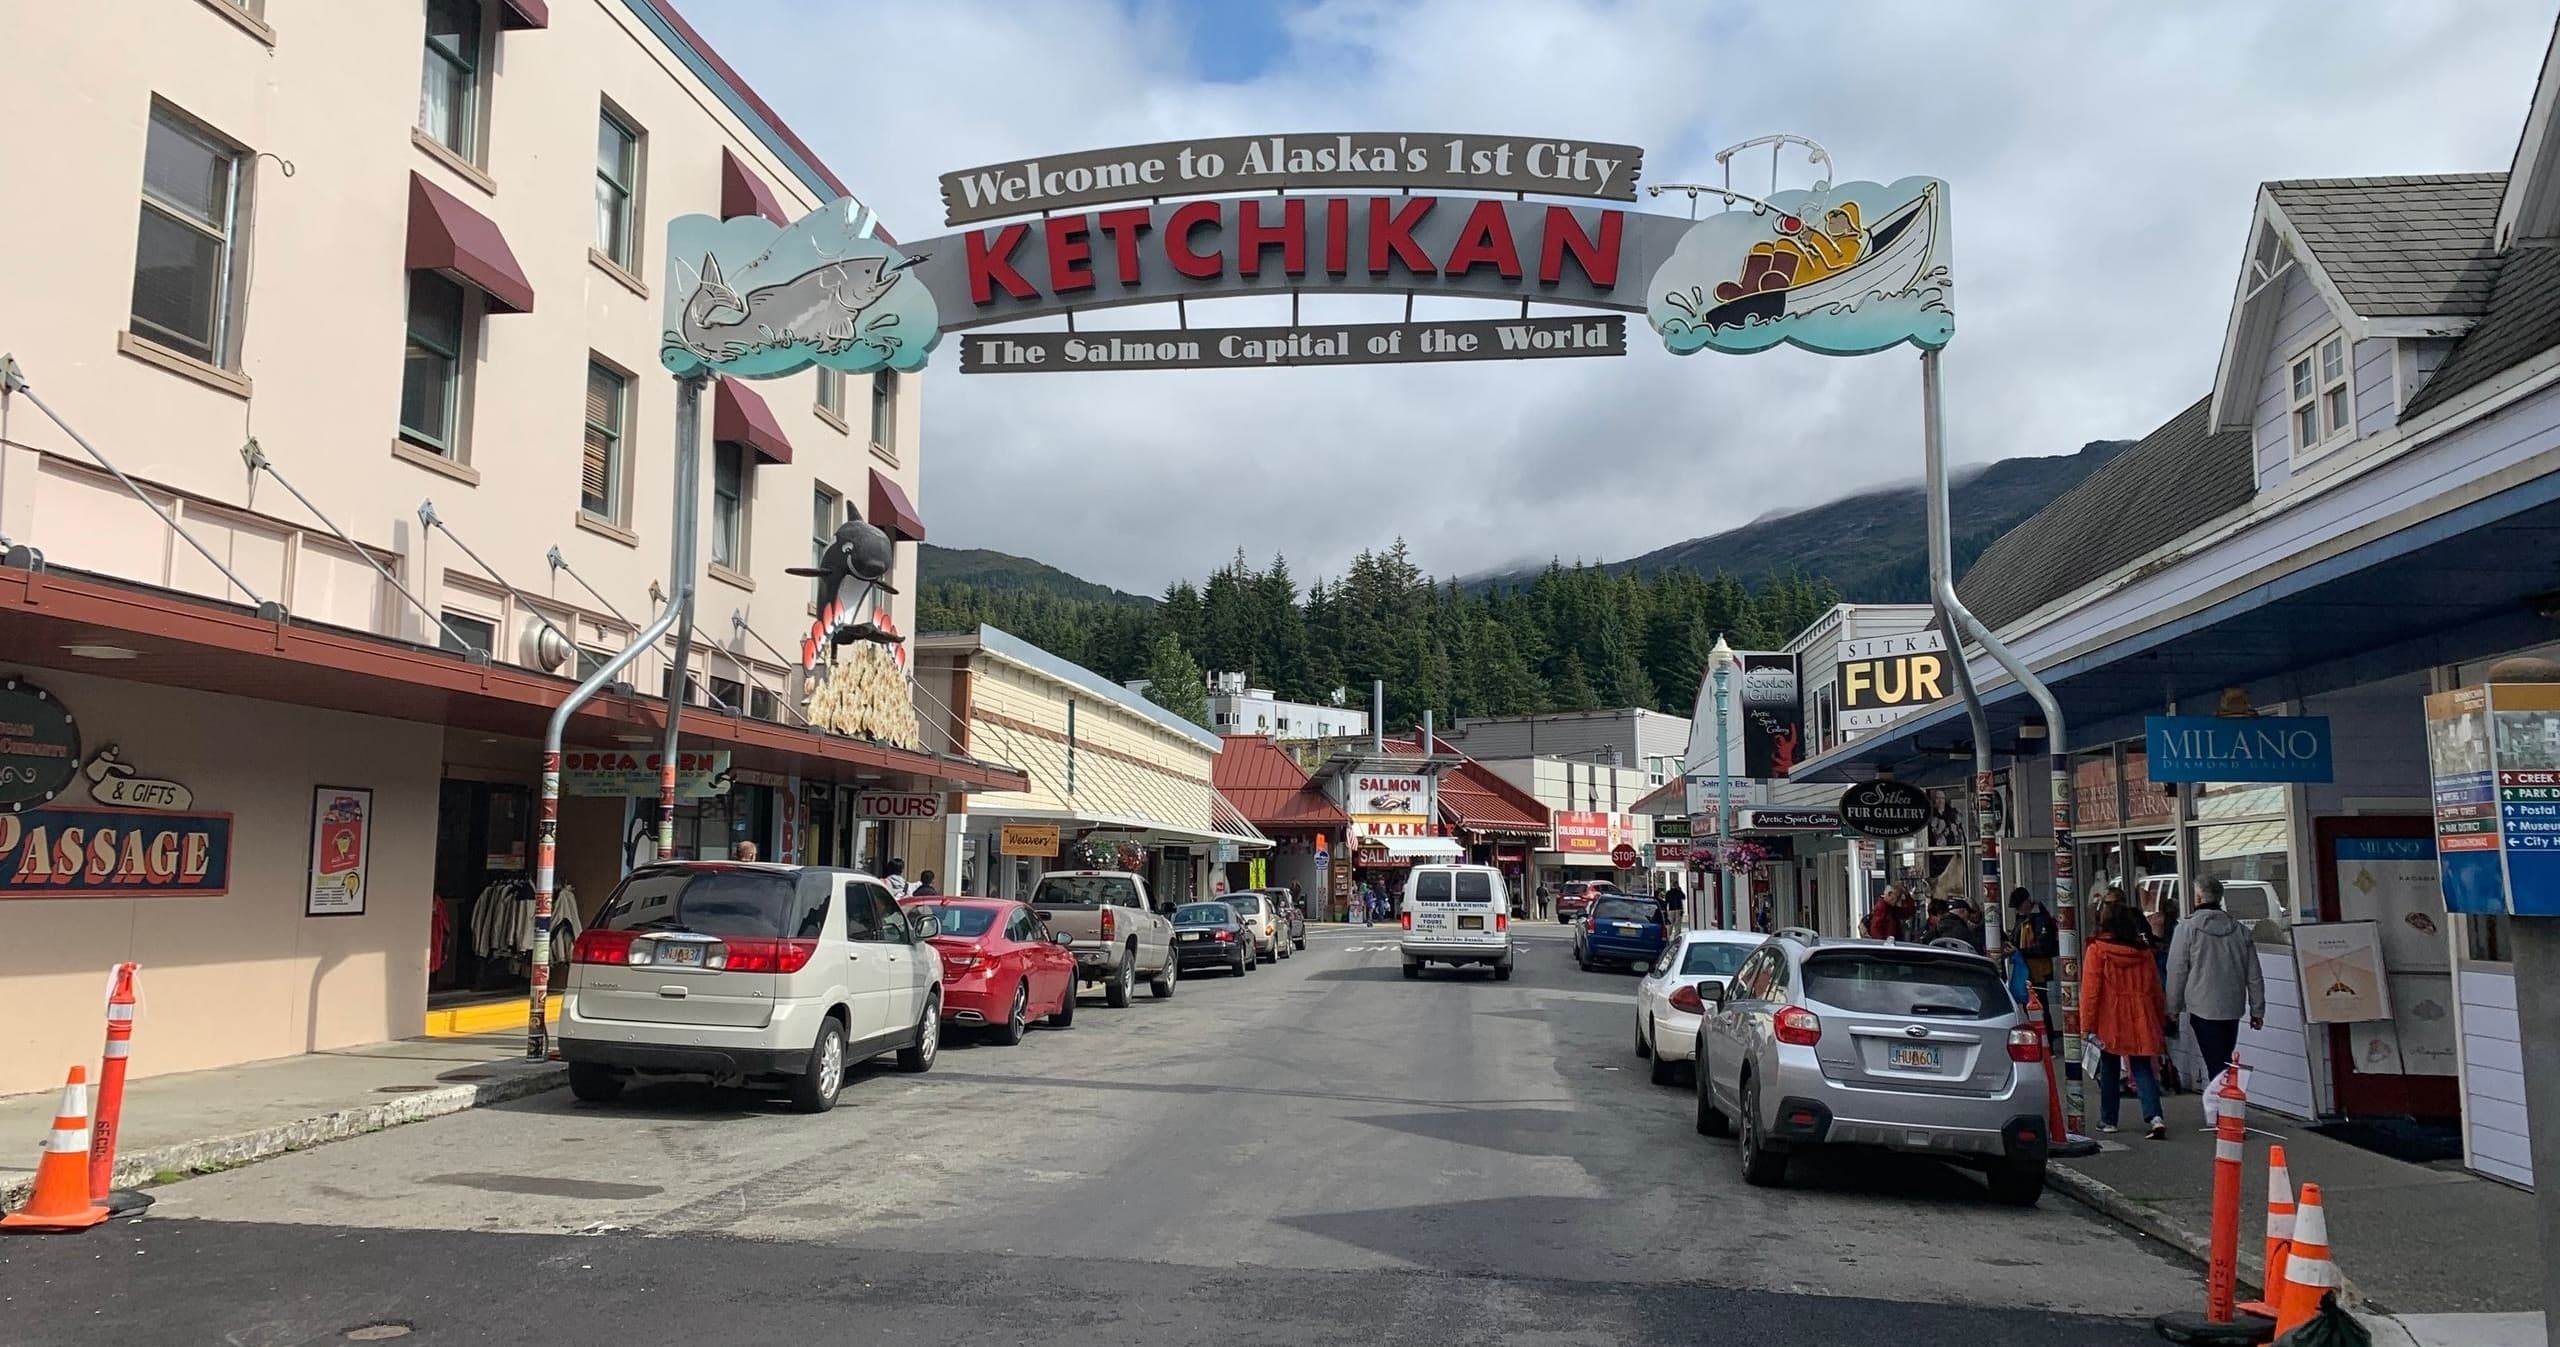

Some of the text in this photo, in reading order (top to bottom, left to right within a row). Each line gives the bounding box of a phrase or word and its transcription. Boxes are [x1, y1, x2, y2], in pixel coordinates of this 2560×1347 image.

[958, 136, 1622, 208] Welcome to Alaska's 1st City
[964, 196, 1624, 307] KETCHIKAN
[977, 324, 1608, 365] The Salmon Capital of the World
[1848, 635, 1939, 657] SITKA
[1846, 655, 1943, 706] FUR
[1766, 725, 1790, 735] Gallery
[2160, 730, 2318, 760] MILANO
[565, 753, 714, 771] ORCA CRN
[2163, 760, 2240, 769] DIAMOND
[1360, 778, 1421, 792] SALMON
[1702, 780, 1732, 788] Salmn
[2518, 774, 2554, 783] CREEK
[112, 781, 176, 805] & GIFTS
[1860, 783, 1911, 805] Sitka
[2519, 788, 2548, 798] PARK
[862, 796, 936, 816] TOURS
[1848, 806, 1926, 819] FUR GALLERY
[2521, 805, 2556, 815] Postal
[1758, 814, 1838, 826] Arctic Spirit Gallery
[2520, 821, 2560, 831] Museu
[1368, 822, 1456, 837] MARKET
[1864, 825, 1910, 835] KETCHIKAN
[1008, 832, 1051, 847] Weavers
[2524, 836, 2549, 848] City
[1613, 851, 1635, 861] STOP
